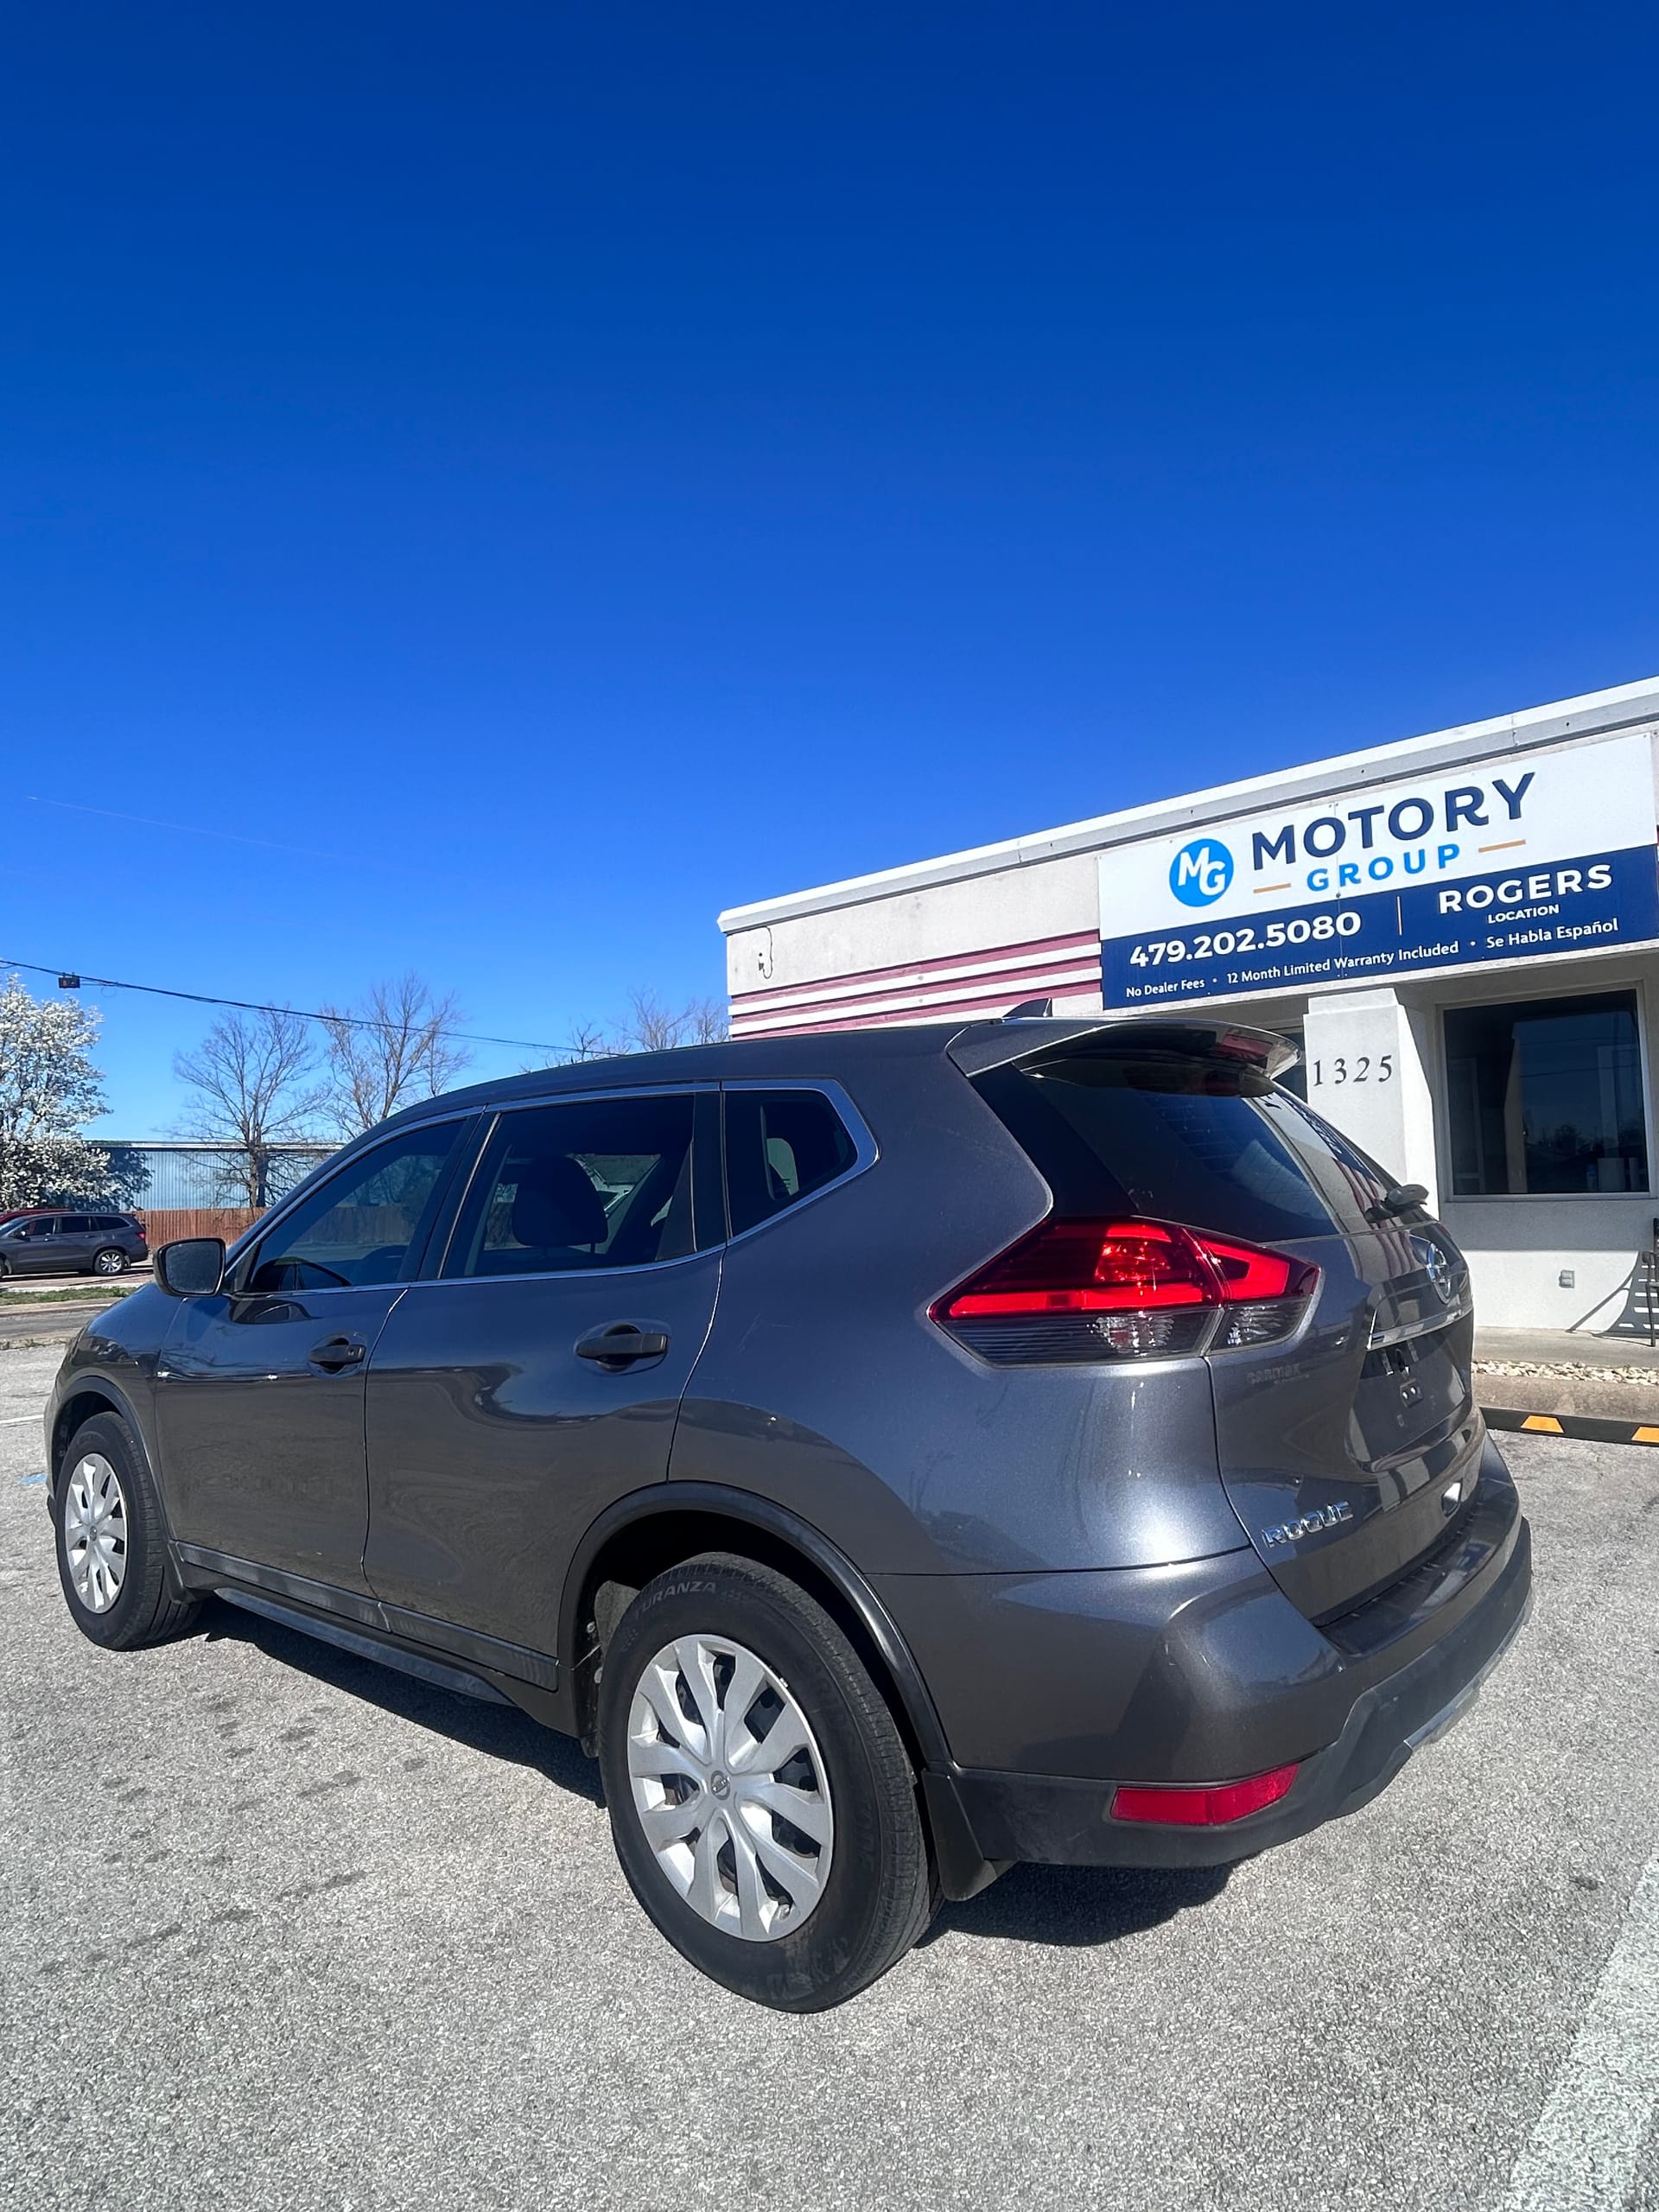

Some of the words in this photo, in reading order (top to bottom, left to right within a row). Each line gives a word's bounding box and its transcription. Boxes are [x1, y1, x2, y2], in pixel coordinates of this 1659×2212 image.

[1252, 772, 1535, 870] MOTORY
[1178, 846, 1225, 896] MG
[1306, 843, 1460, 892] GROUP
[1439, 864, 1612, 914] ROGERS
[1487, 904, 1560, 924] LOCATION
[1126, 987, 1141, 998] No
[1144, 981, 1179, 995] Dealer
[1181, 978, 1205, 989] Fees
[1227, 972, 1238, 983] 12
[1242, 967, 1281, 982] Month
[1284, 958, 1331, 976] Limited
[1334, 950, 1394, 969] Warranty
[1399, 941, 1459, 961] Included
[1486, 936, 1504, 949] Se
[1509, 929, 1553, 946] Habla
[1557, 918, 1618, 940] Español
[1129, 912, 1362, 968] 479.202.5080
[1313, 1054, 1392, 1086] 1325
[1262, 1501, 1354, 1548] ROGUE
